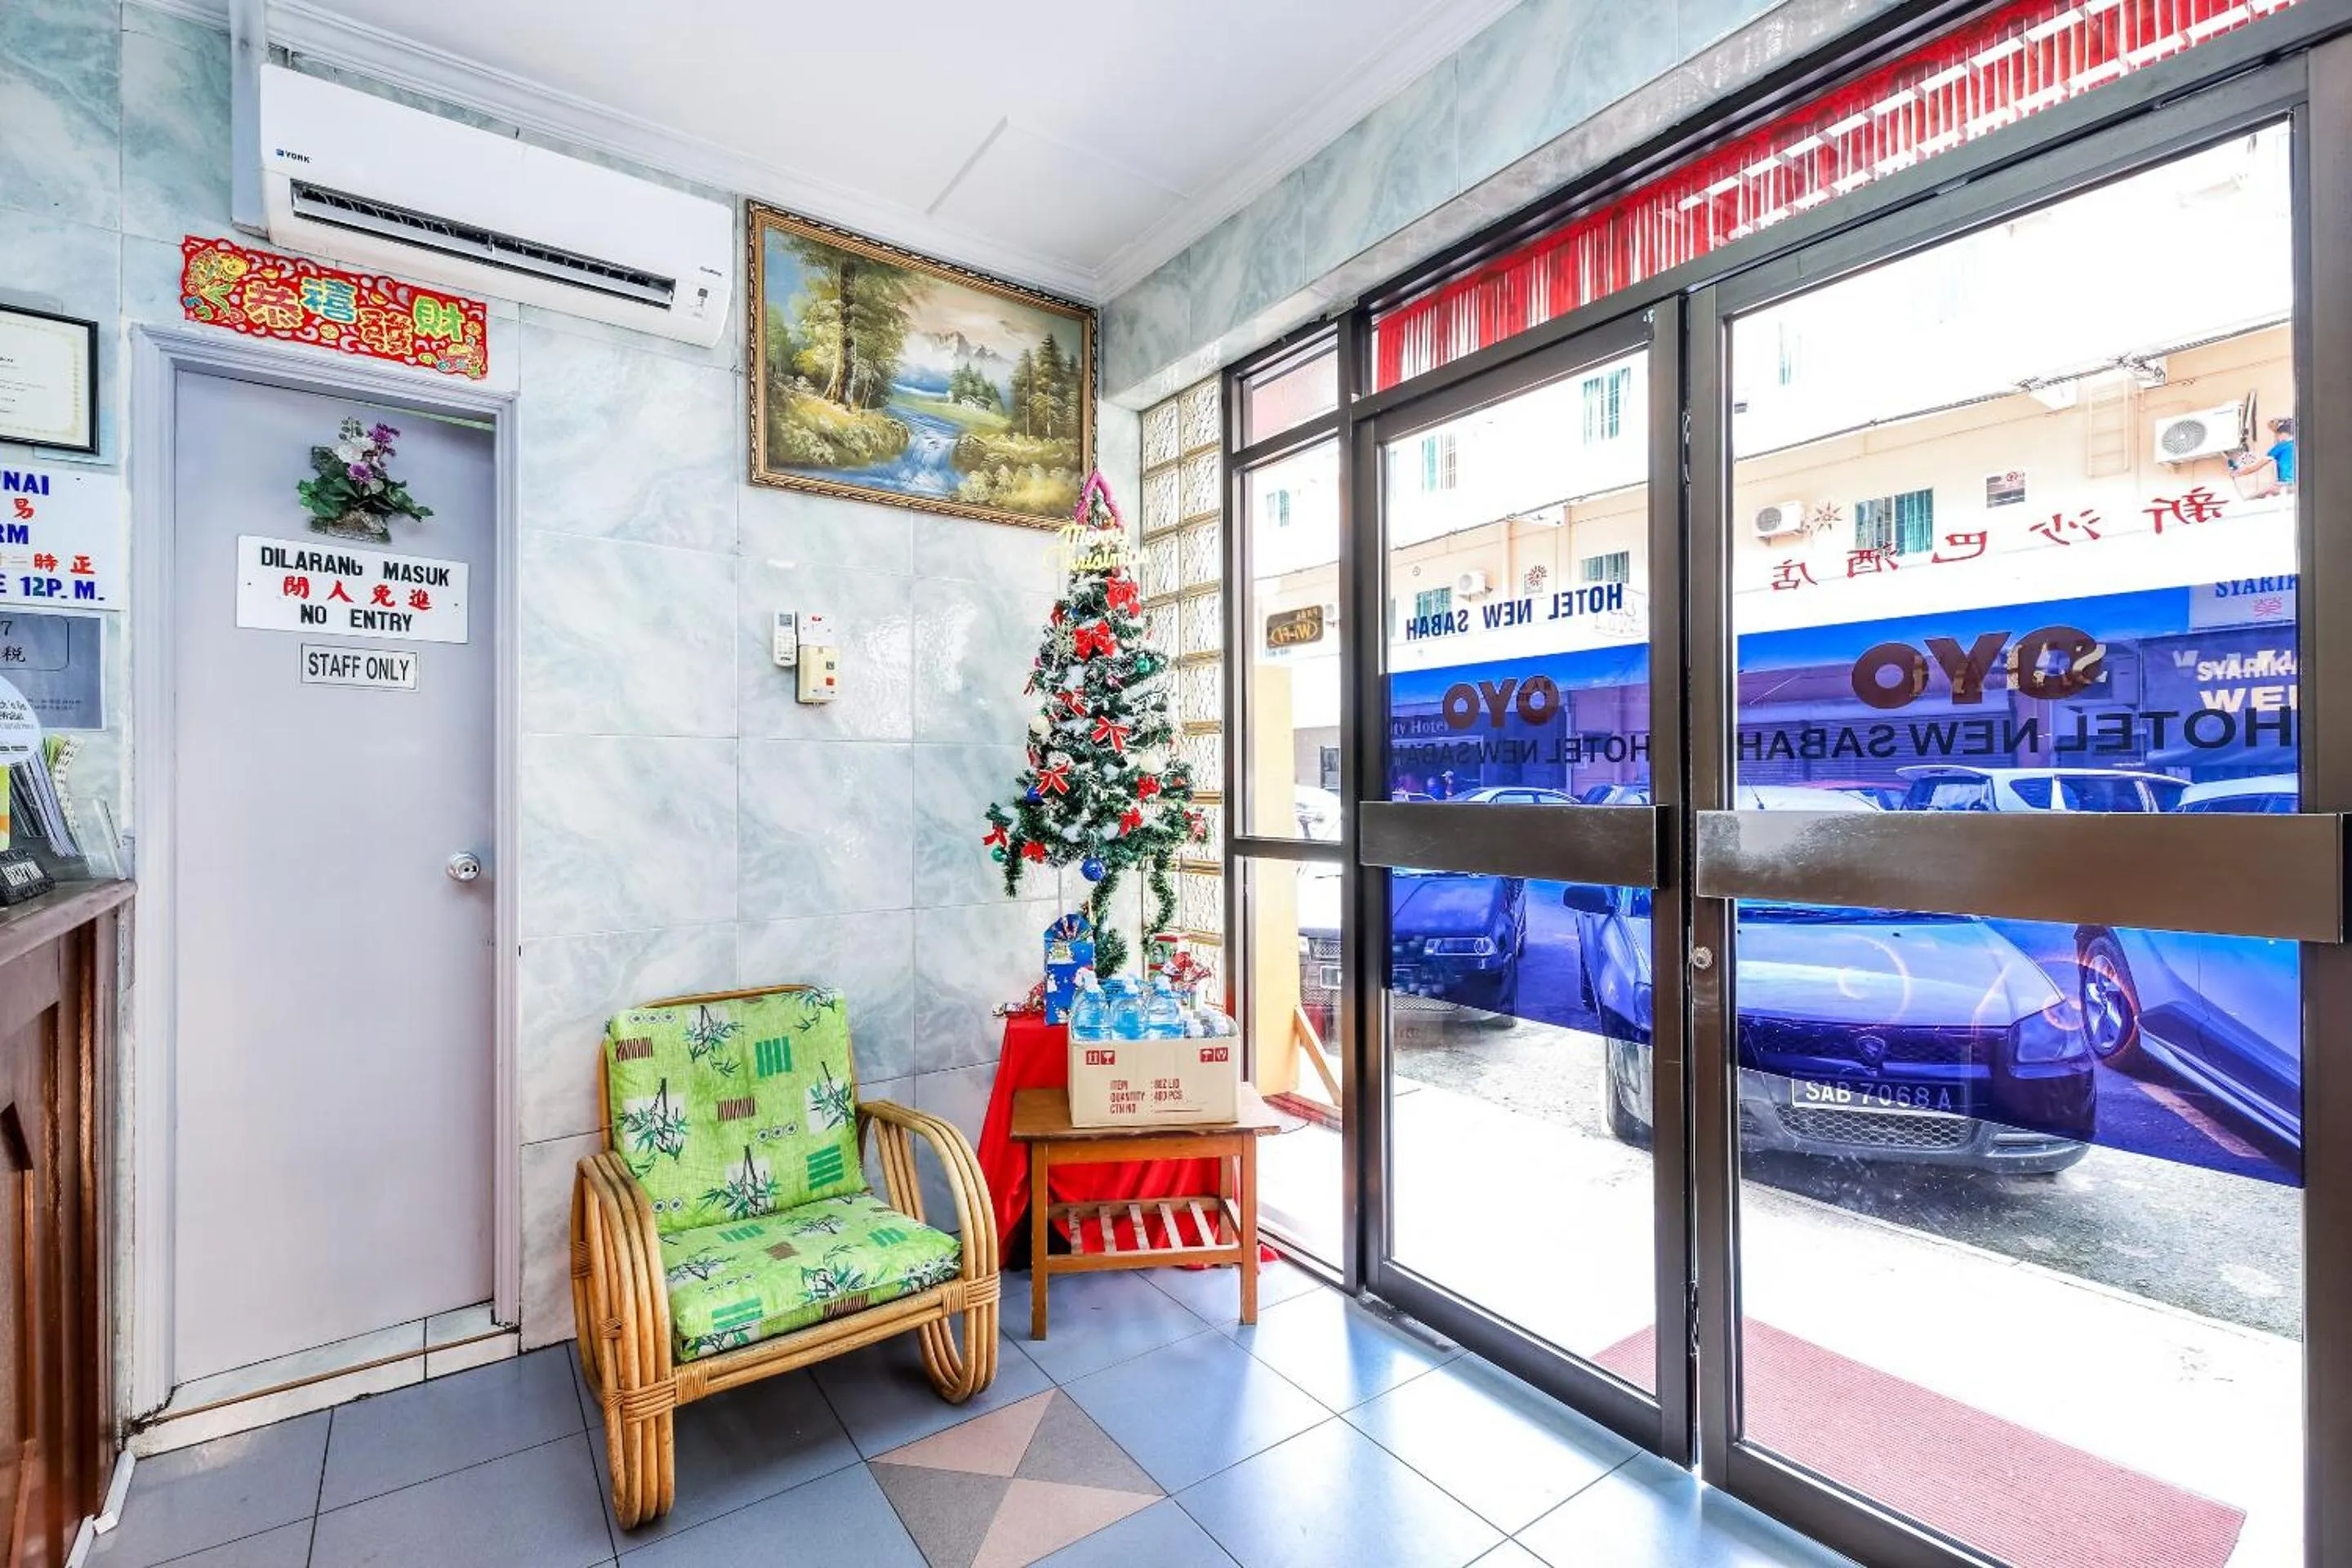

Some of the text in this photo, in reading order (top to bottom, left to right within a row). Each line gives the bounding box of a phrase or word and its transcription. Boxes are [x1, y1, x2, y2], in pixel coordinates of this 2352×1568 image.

[0, 470, 50, 496] NAI
[261, 546, 450, 586] DILARANG MASUK
[301, 604, 413, 632] NO ENTRY
[308, 652, 410, 681] STAFF ONLY
[1805, 1080, 1952, 1111] SAB 7068 A
